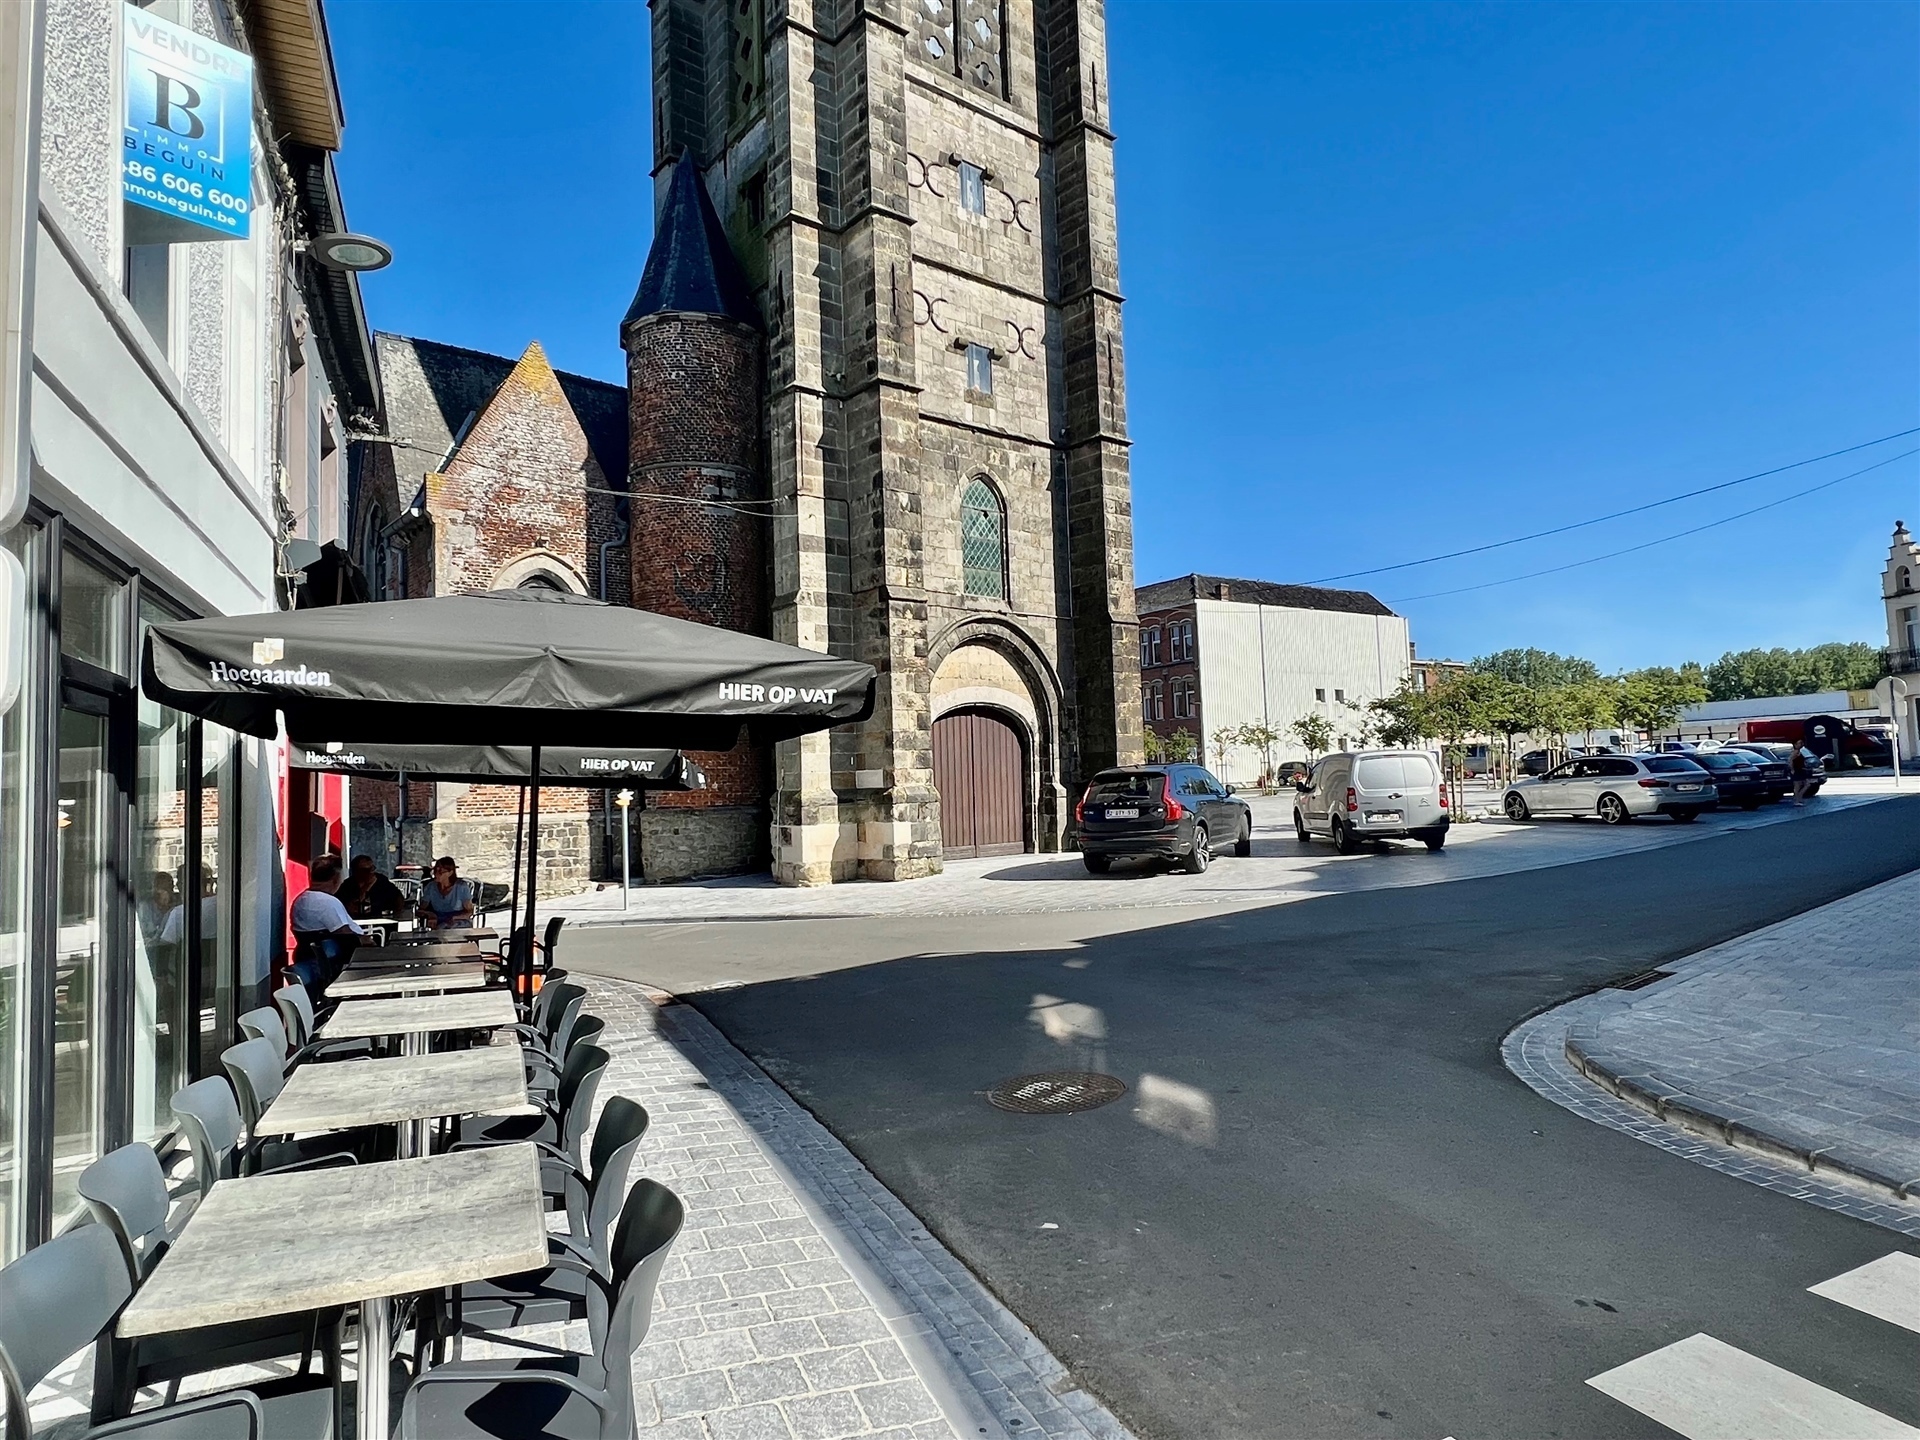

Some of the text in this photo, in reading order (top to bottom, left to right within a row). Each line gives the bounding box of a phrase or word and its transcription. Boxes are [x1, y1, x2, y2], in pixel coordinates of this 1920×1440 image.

[147, 68, 204, 140] B
[124, 135, 224, 181] BEGUIN
[143, 130, 208, 159] IMMO
[161, 172, 203, 198] 606
[208, 188, 248, 213] 600
[209, 661, 332, 686] Hoegaarden
[718, 682, 837, 705] HIER OP VAT
[305, 750, 366, 765] Hoegaarden
[580, 758, 655, 772] HIER OP VAT
